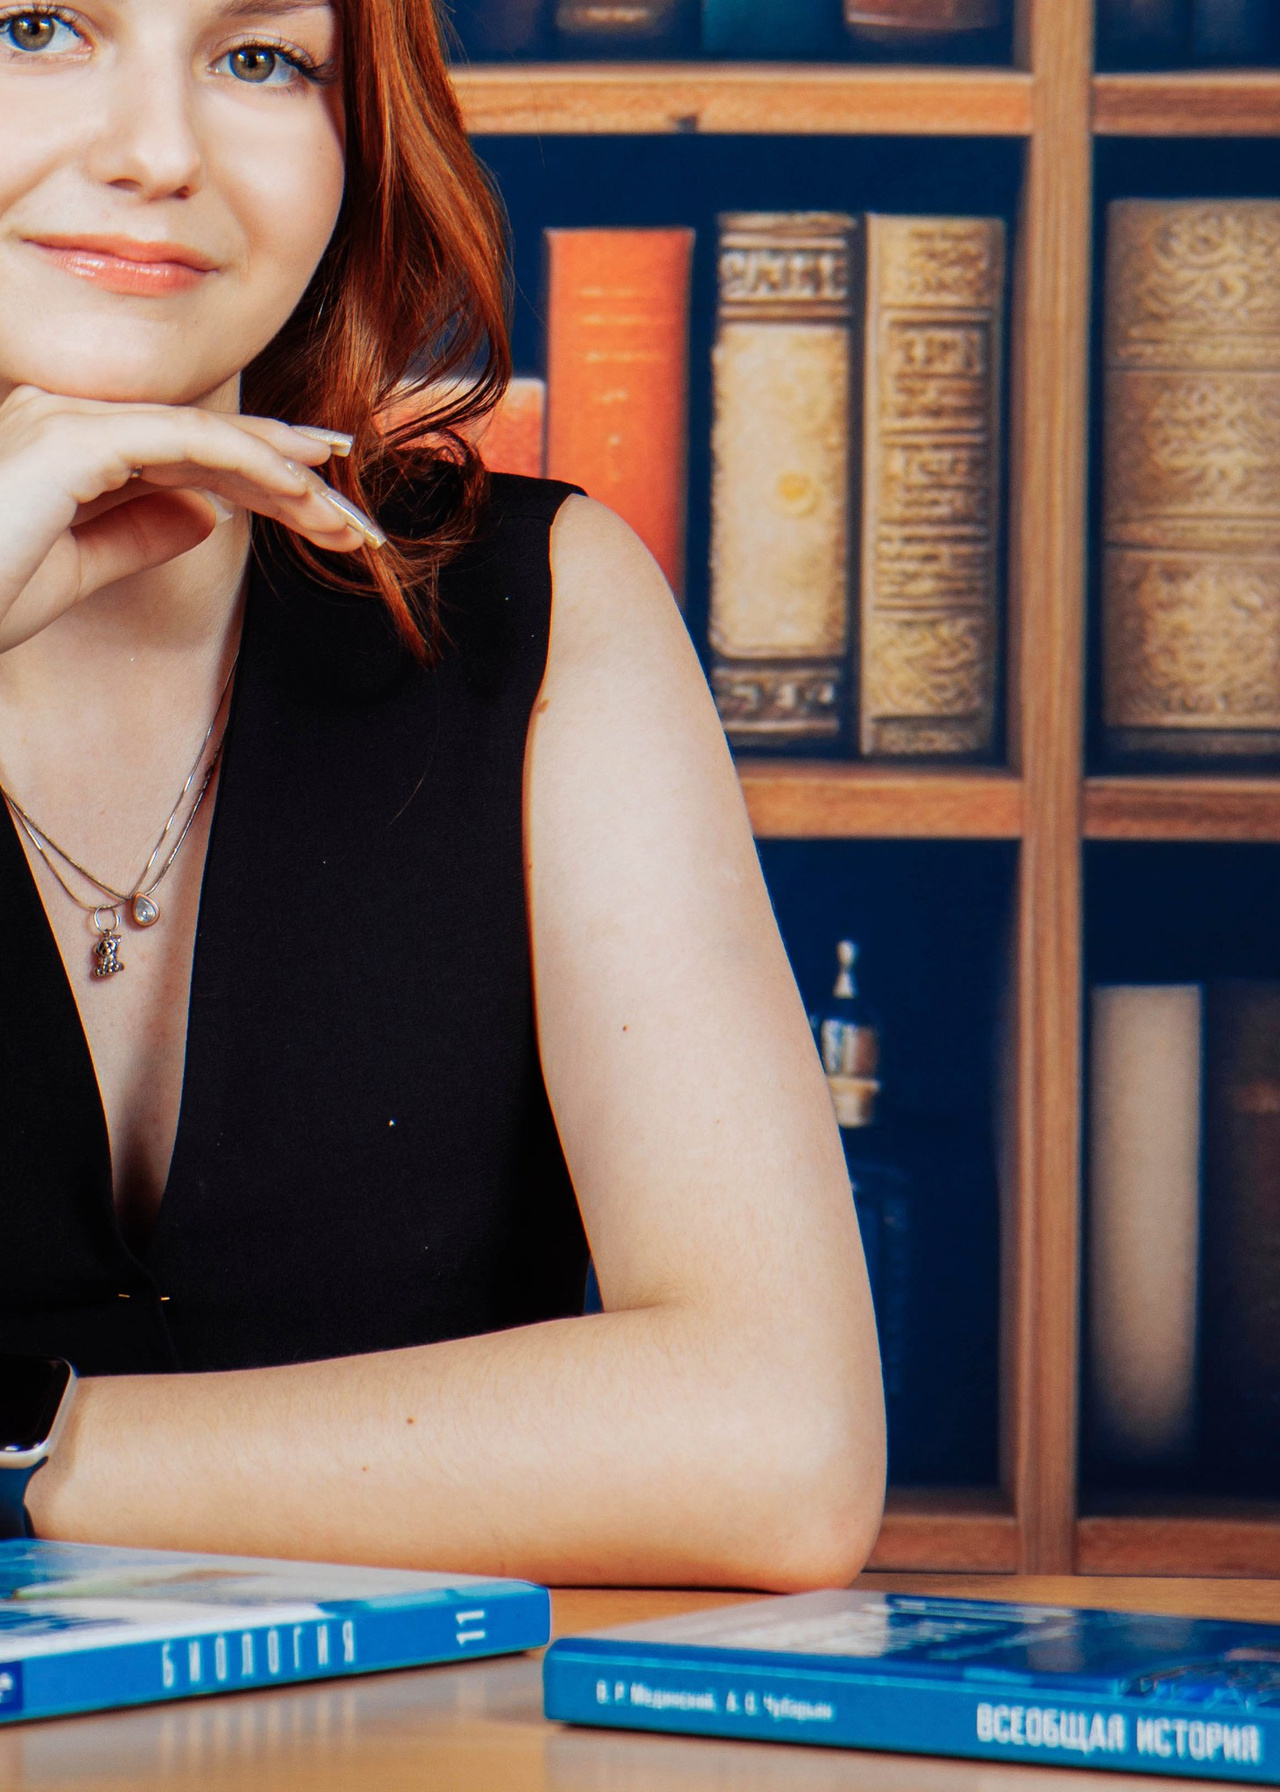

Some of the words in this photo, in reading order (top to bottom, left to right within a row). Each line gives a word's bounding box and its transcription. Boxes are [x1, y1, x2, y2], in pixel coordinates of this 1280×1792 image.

[161, 1619, 356, 1689] БИОЛОГИЯ
[455, 1609, 486, 1646] 11
[976, 1702, 1126, 1756] ВСЕОБЩАЯ
[1136, 1716, 1262, 1766] ИСТОРИЯ
